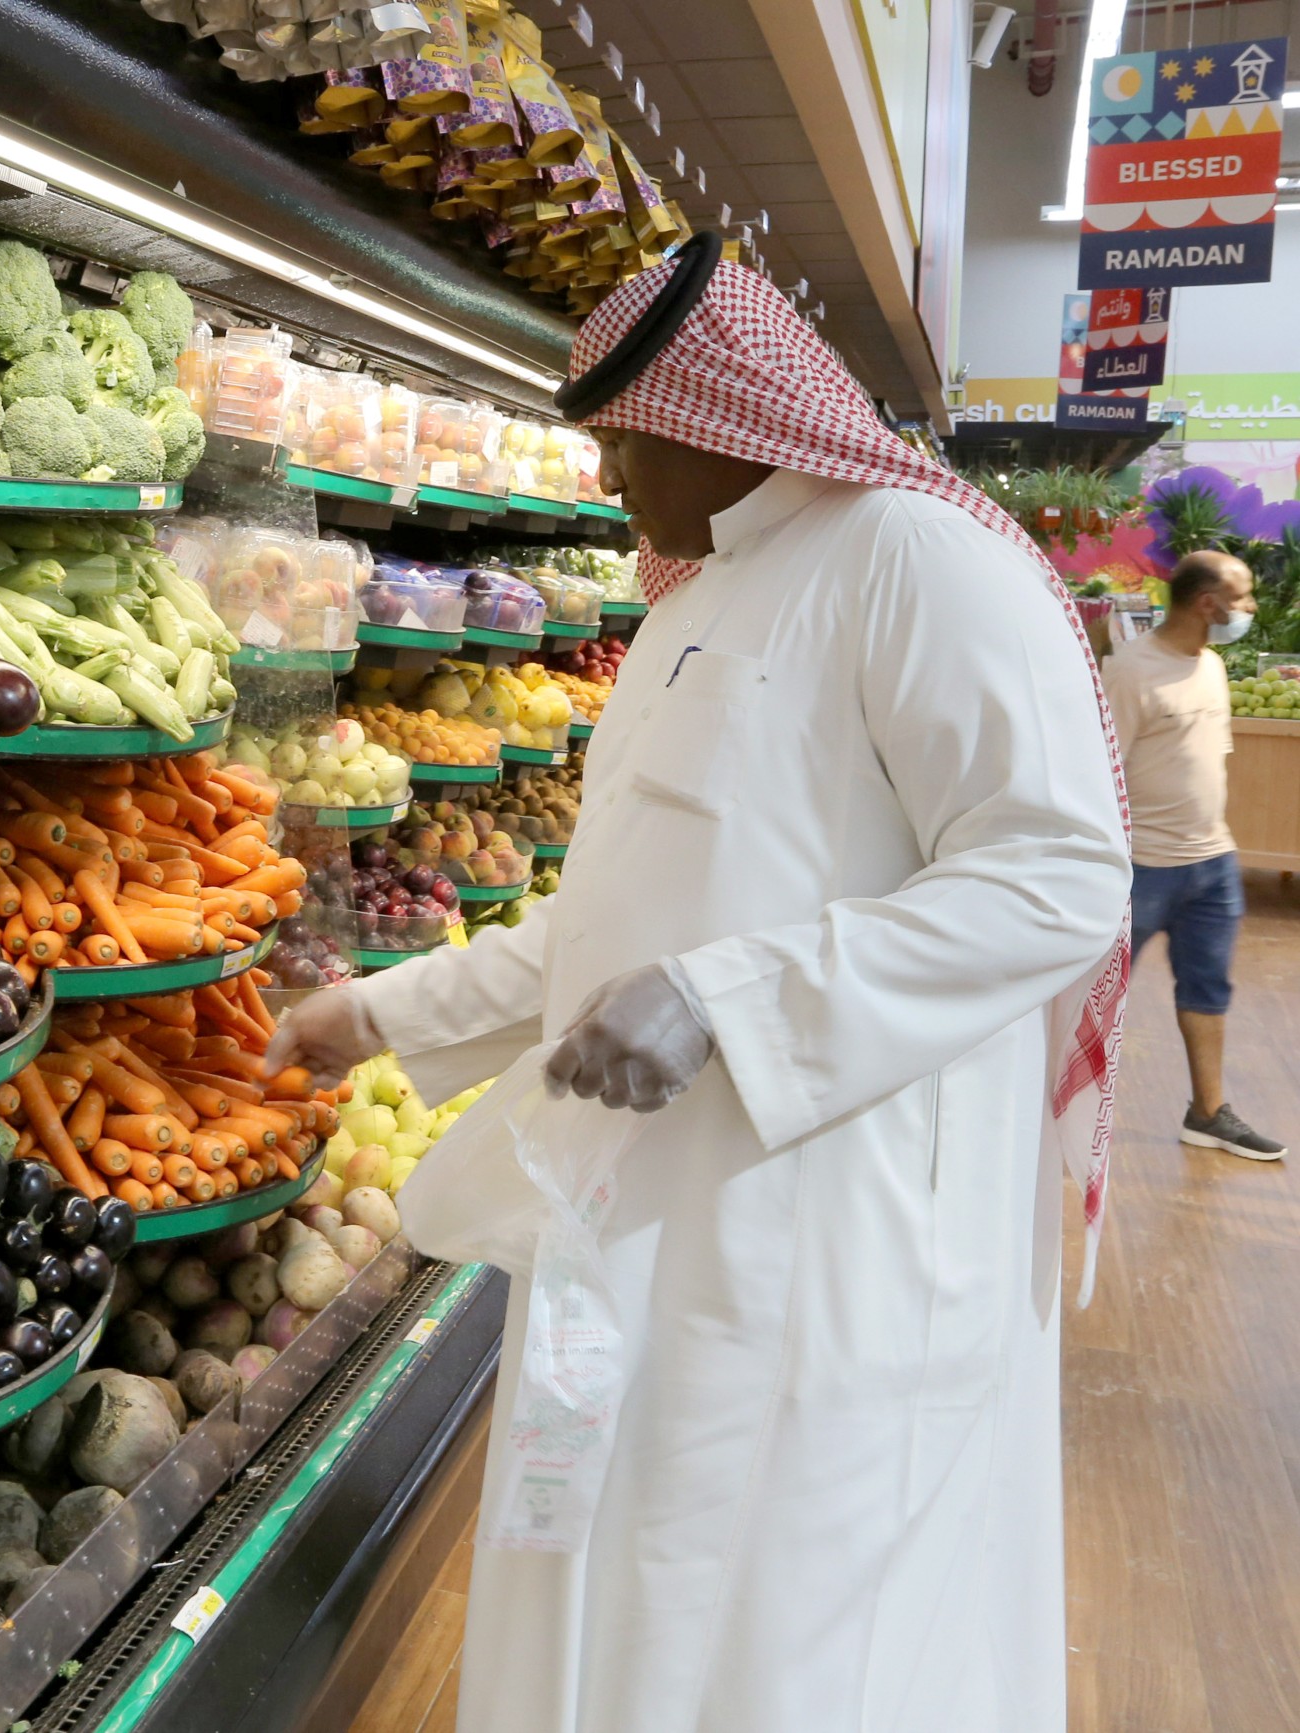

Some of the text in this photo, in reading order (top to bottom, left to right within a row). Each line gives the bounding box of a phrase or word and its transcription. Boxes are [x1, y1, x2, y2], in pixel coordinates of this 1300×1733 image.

[1119, 155, 1243, 184] BLESSED
[1105, 243, 1246, 271] RAMADAN
[1096, 353, 1148, 380] العطاء
[1068, 404, 1136, 420] RAMADAN
